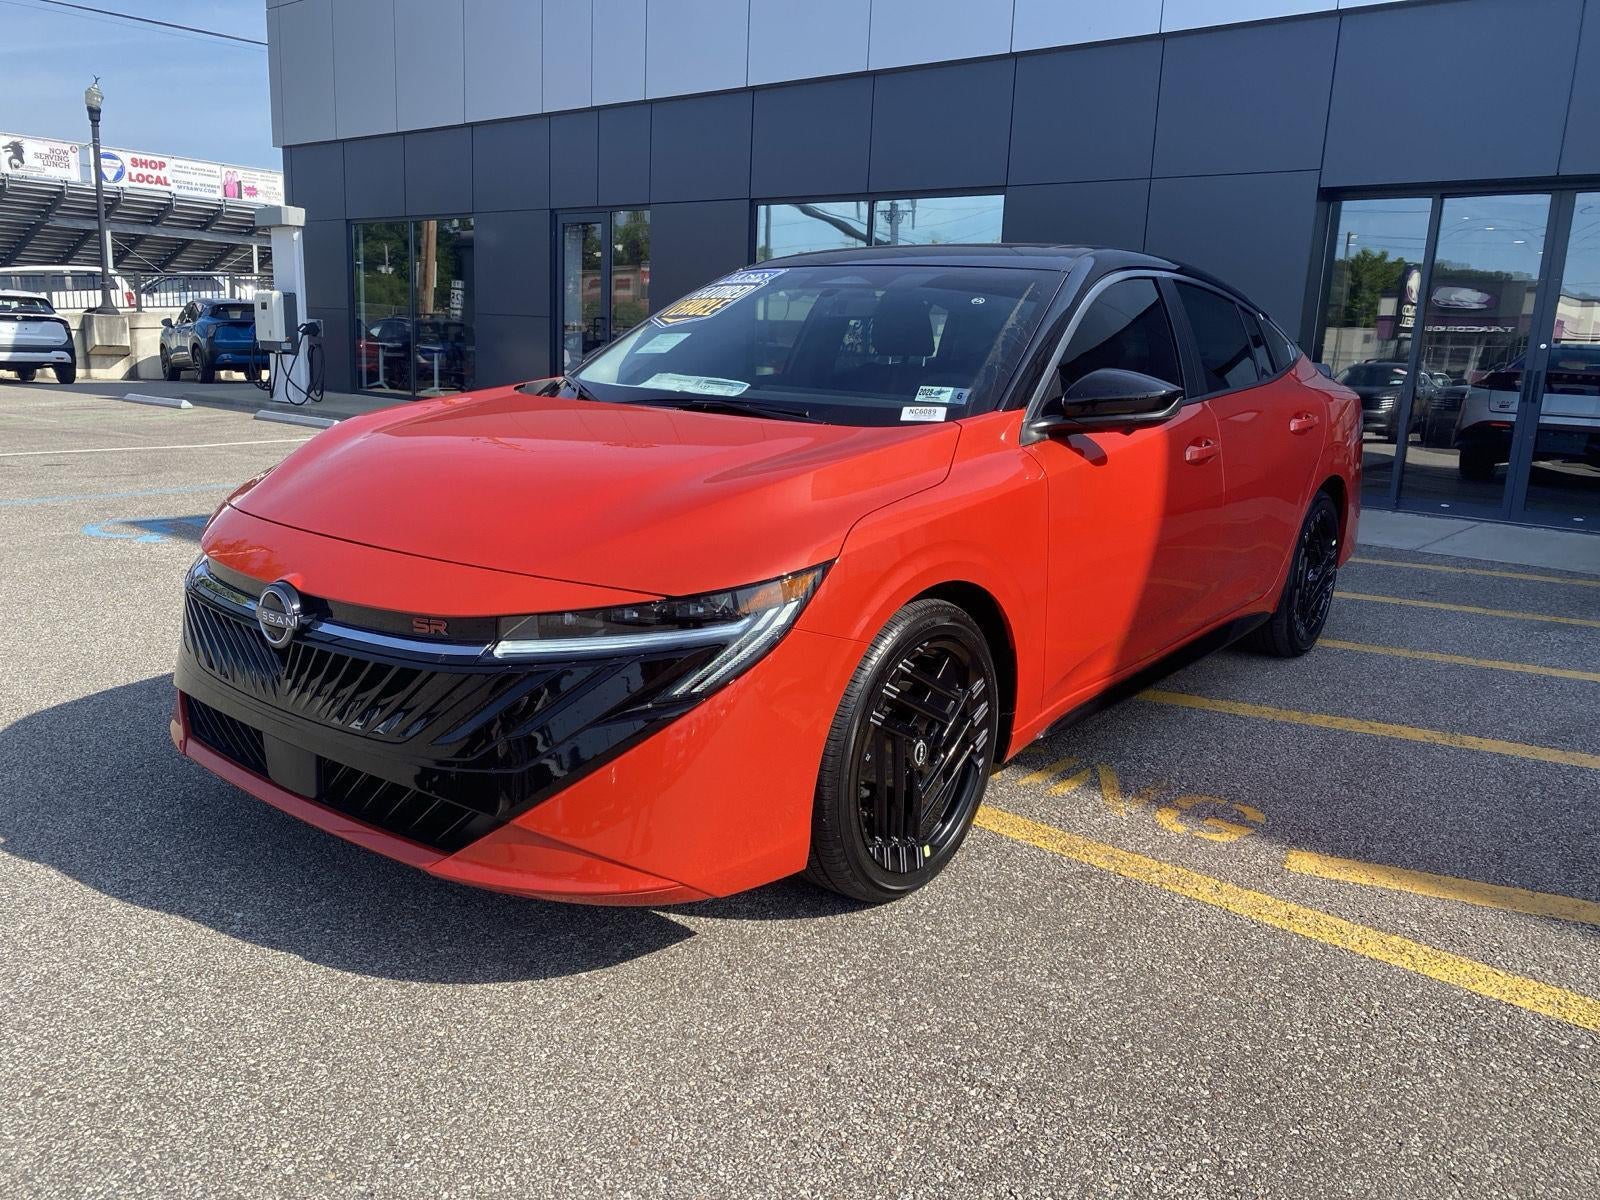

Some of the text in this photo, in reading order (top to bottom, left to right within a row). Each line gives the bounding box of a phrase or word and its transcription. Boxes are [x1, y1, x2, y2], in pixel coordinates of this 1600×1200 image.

[49, 147, 69, 156] NOW
[33, 152, 70, 163] SERVING
[42, 160, 71, 169] LUNCH
[130, 157, 167, 171] SHOP
[127, 171, 171, 187] LOCAL
[956, 392, 964, 400] 6
[412, 618, 449, 636] SR
